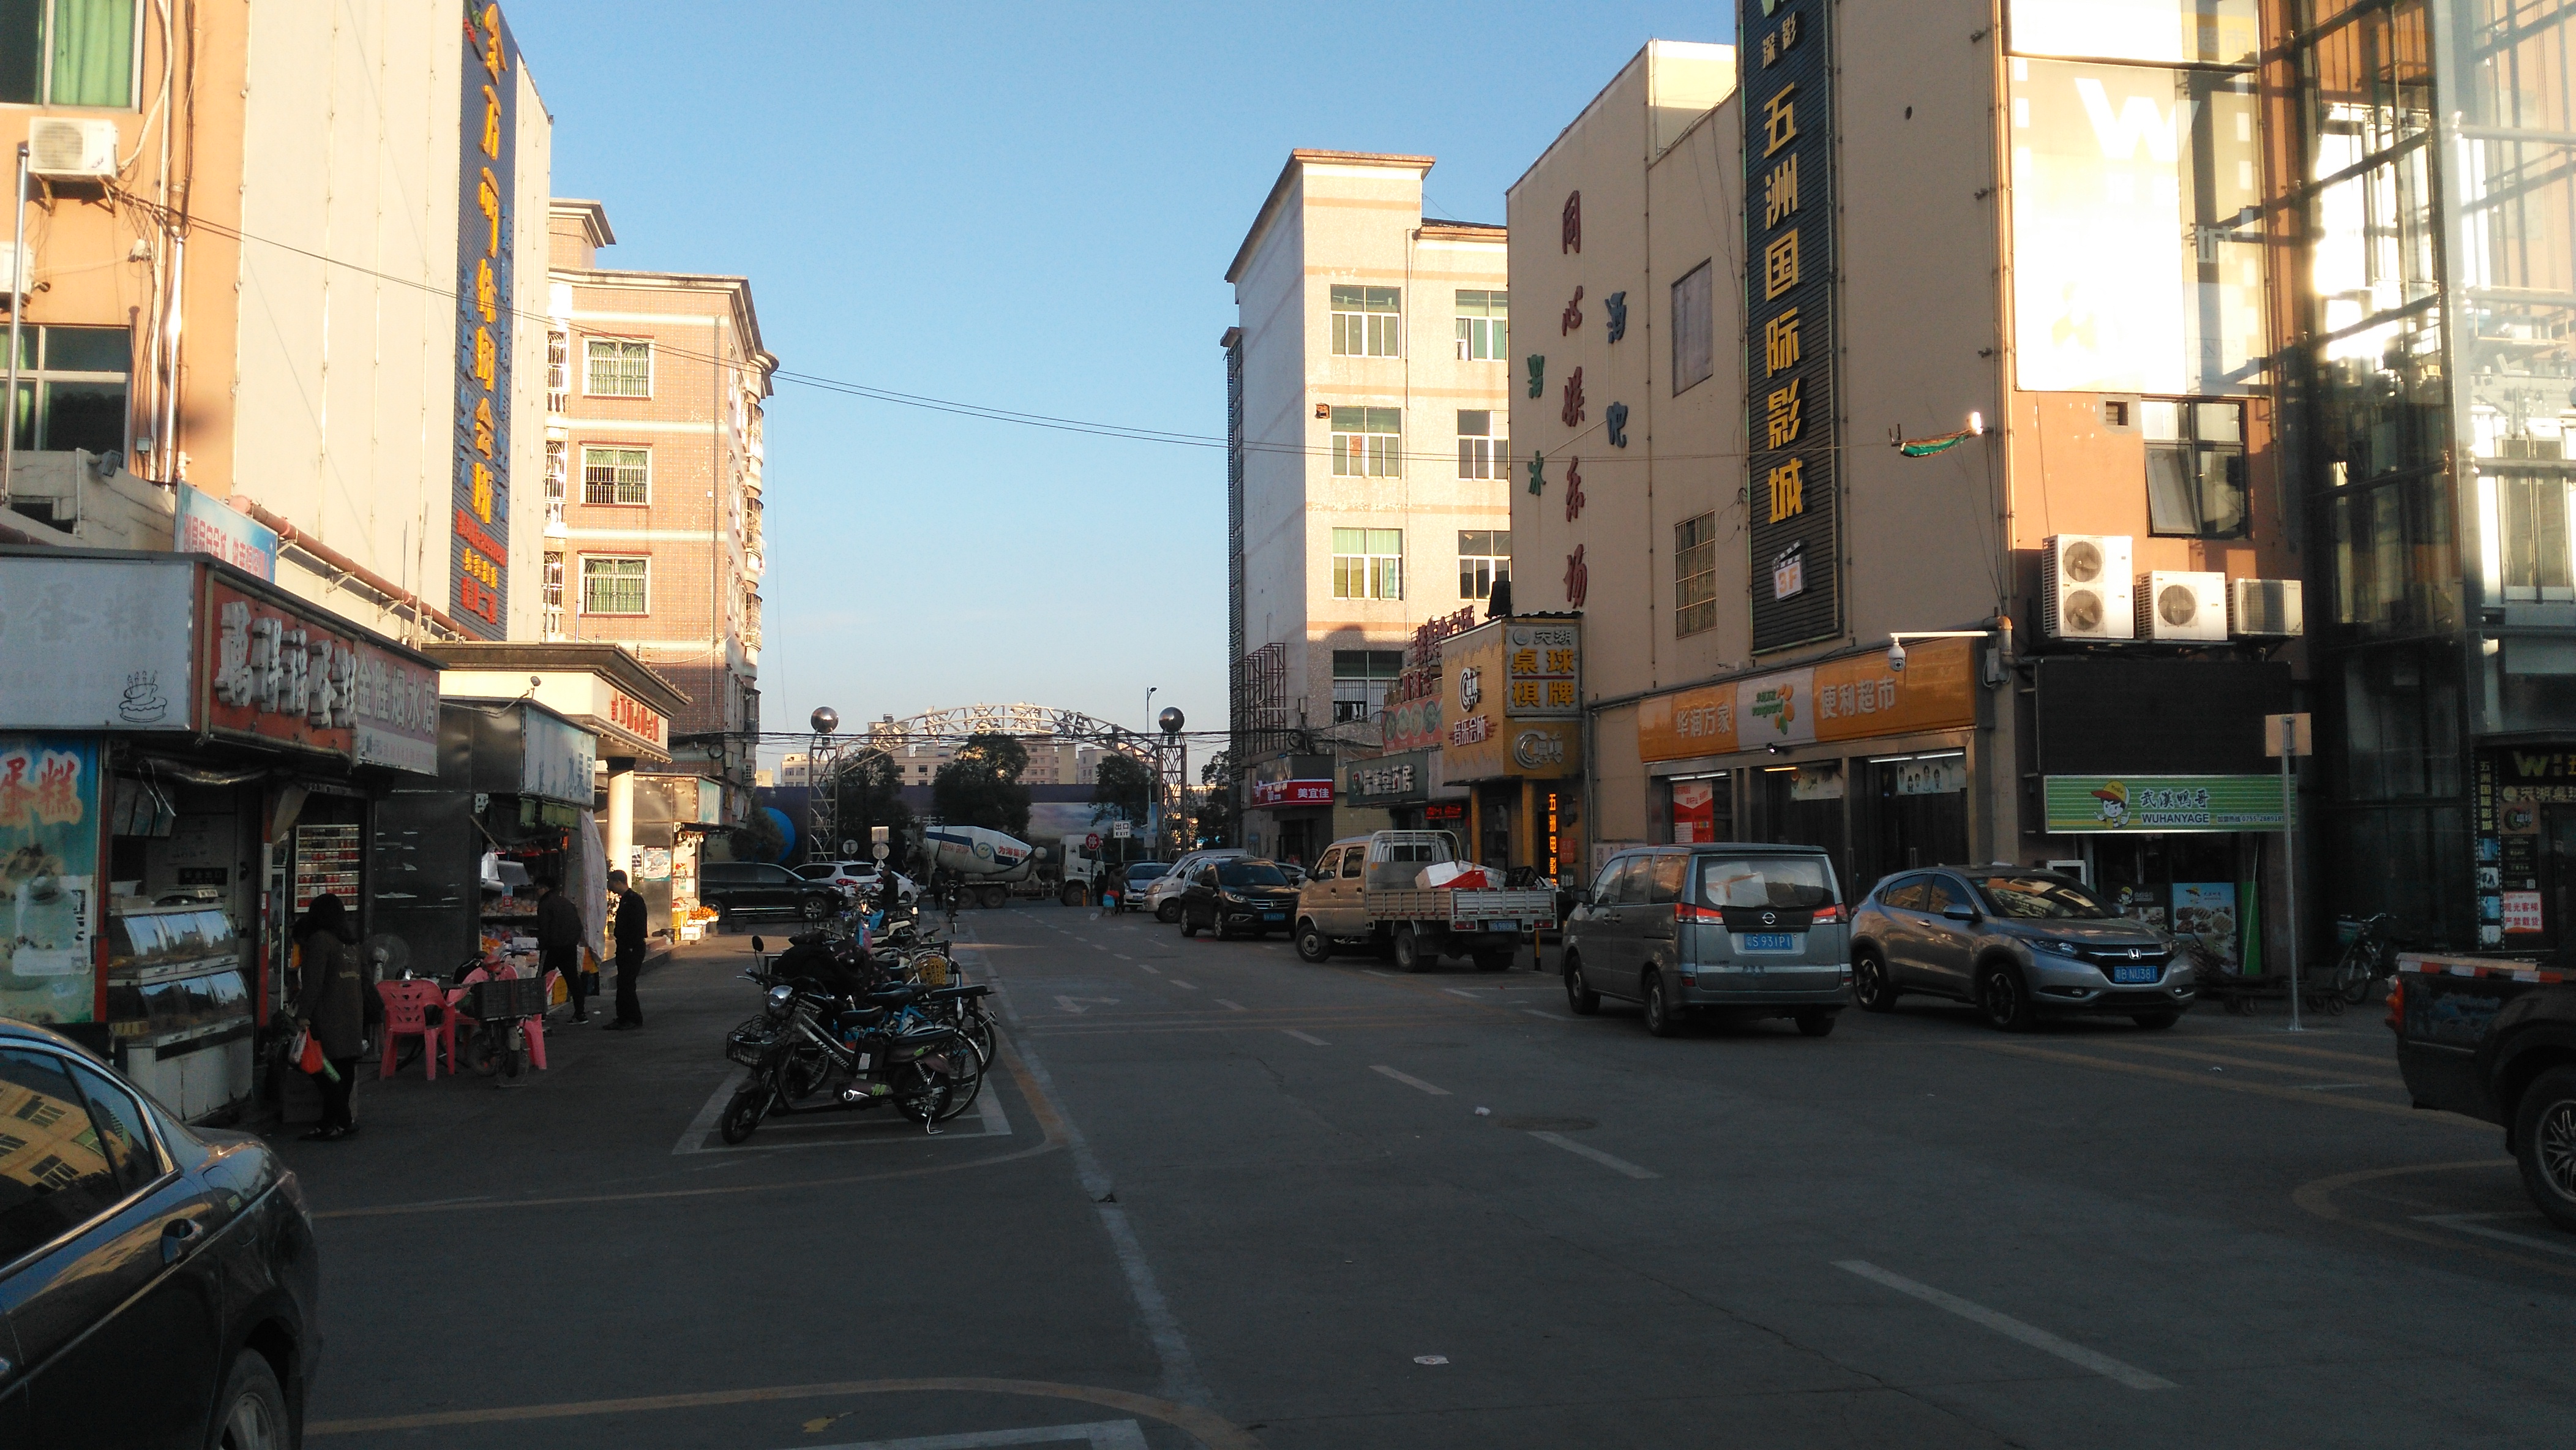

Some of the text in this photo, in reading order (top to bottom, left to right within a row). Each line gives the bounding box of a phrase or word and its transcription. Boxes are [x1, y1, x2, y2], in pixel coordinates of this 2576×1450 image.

[1763, 81, 1804, 524] 五洲国际影城
[1778, 568, 1799, 594] 3F
[1511, 648, 1574, 674] 桌球
[1512, 681, 1576, 707] 棋牌
[1821, 676, 1897, 720] 便利超市
[1455, 715, 1486, 746] 音乐会所
[1676, 704, 1731, 738] 华润万家
[1298, 788, 1330, 798] 美宜佳
[2143, 813, 2209, 824] WUHANYAGE
[998, 845, 1027, 857] 为海集团
[1088, 836, 1097, 847] 停
